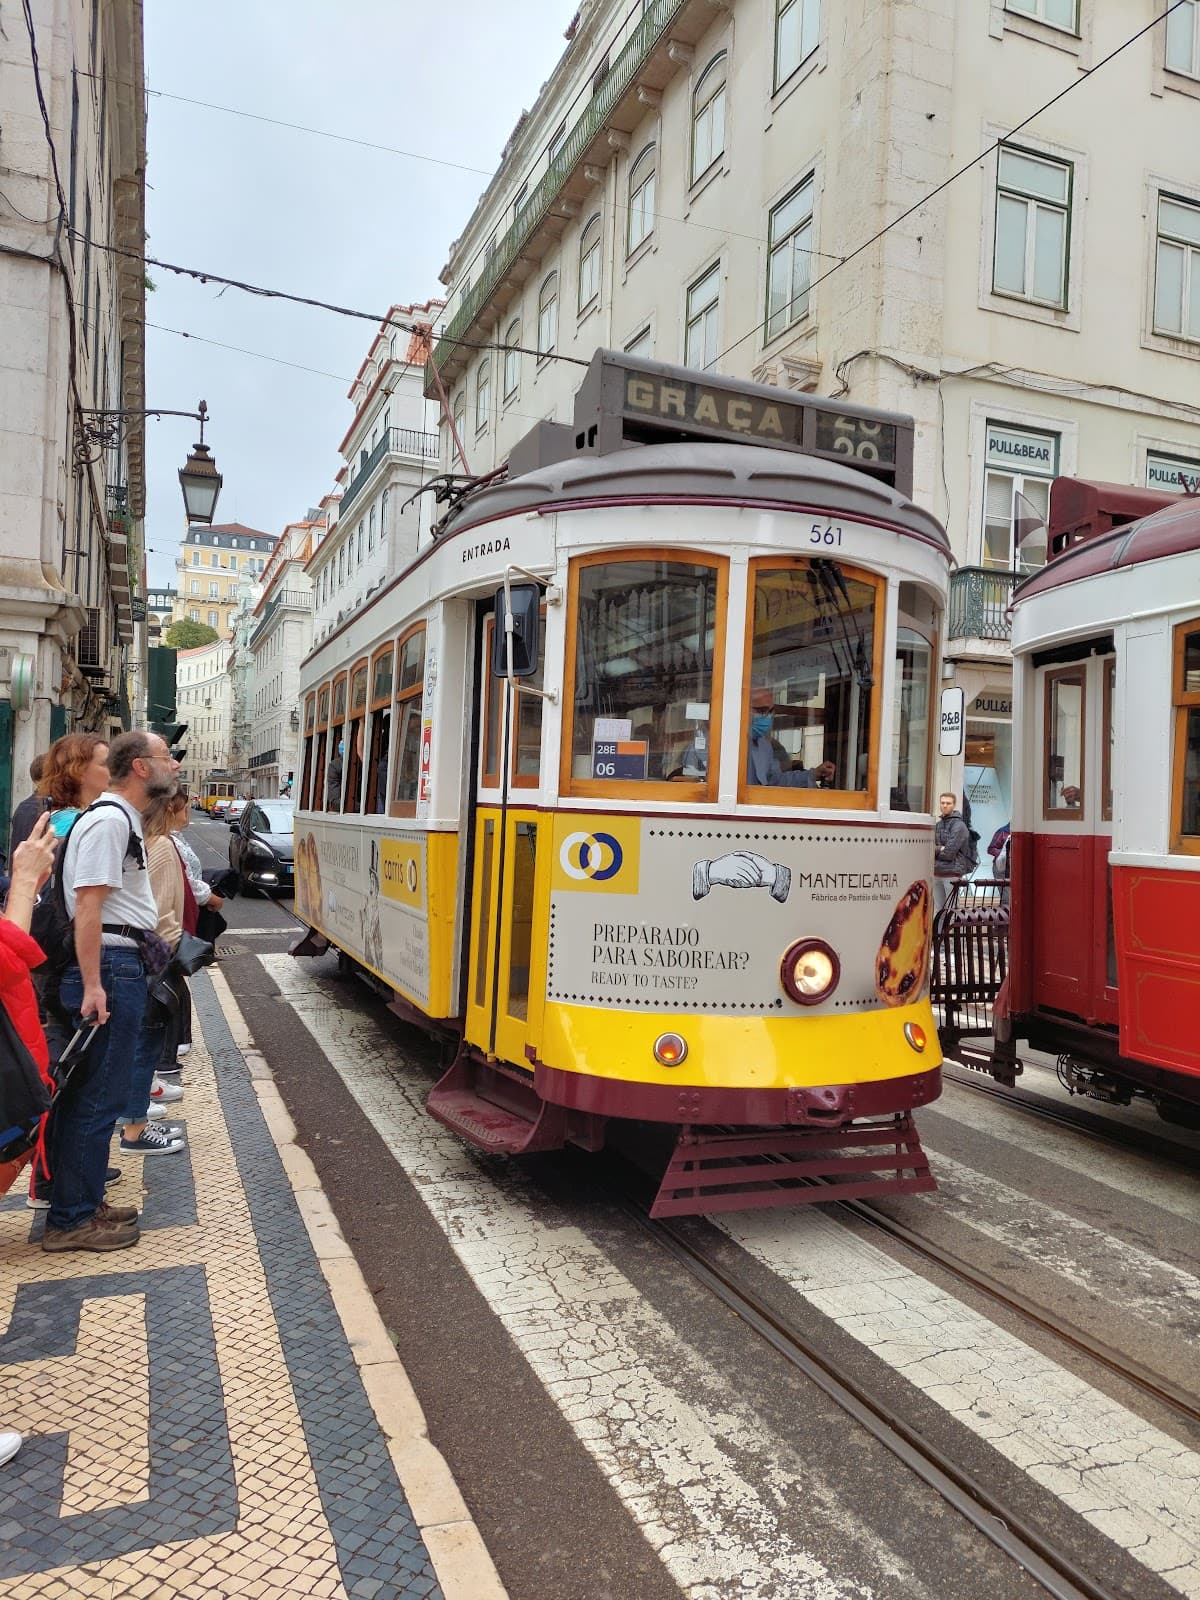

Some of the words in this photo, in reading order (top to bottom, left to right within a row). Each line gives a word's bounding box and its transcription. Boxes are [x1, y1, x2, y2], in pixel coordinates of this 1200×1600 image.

[627, 379, 784, 435] GRAÇA
[989, 438, 1050, 461] PULL&BEAR
[810, 525, 842, 546] 561
[462, 537, 511, 563] ENTRADA
[941, 711, 960, 725] P&B
[597, 745, 616, 755] 28E
[596, 762, 616, 776] 06
[384, 853, 404, 885] carris
[799, 872, 898, 888] MANTEIGARIA
[838, 894, 848, 902] de
[593, 923, 700, 947] PREPARADO
[592, 945, 638, 966] PARA
[643, 948, 750, 970] SABOREAR?
[591, 970, 630, 986] READY
[632, 974, 649, 987] TO
[652, 974, 698, 990] TASTE?
